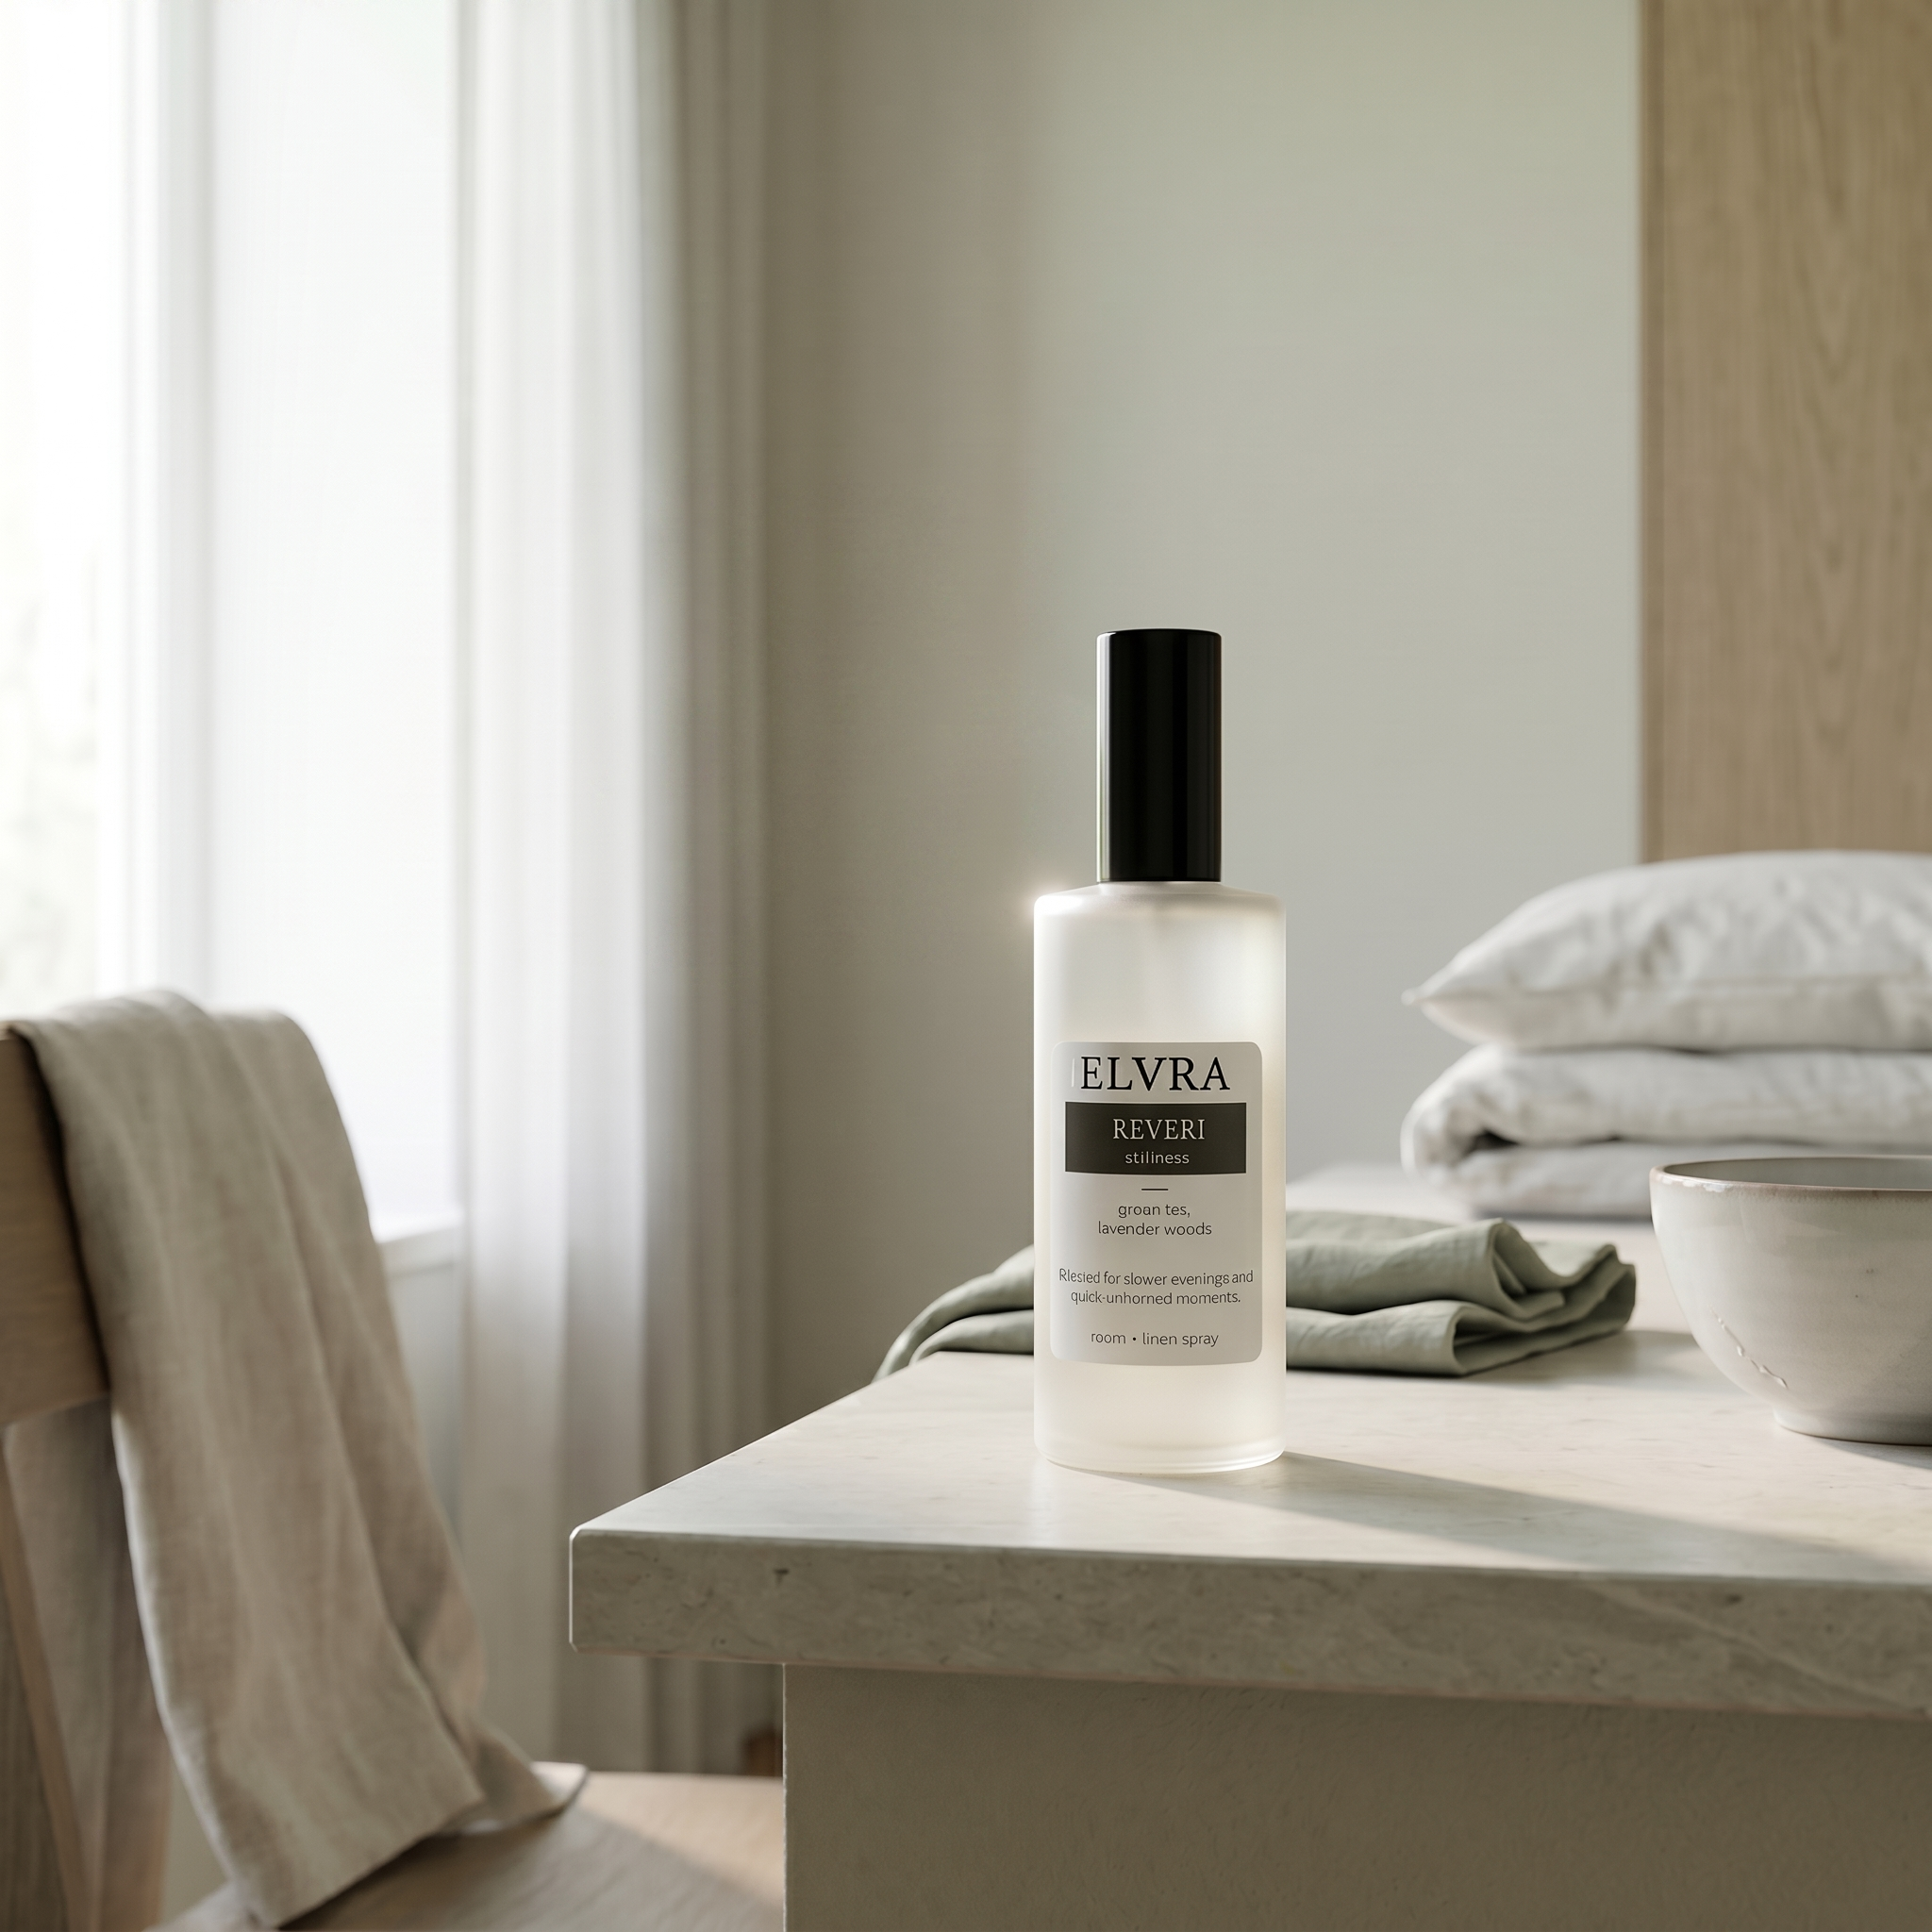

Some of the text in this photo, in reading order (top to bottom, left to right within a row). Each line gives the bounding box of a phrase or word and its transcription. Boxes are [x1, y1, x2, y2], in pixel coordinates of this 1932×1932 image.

[1081, 1056, 1230, 1091] ELVRA
[1112, 1118, 1206, 1140] REVERI
[1165, 1204, 1191, 1218] tes,
[1098, 1221, 1212, 1235] lavender woods
[1104, 1271, 1121, 1285] for
[1124, 1272, 1167, 1286] slower
[1171, 1273, 1229, 1288] evenings
[1232, 1270, 1254, 1283] and
[1176, 1291, 1241, 1305] moments.
[1091, 1332, 1219, 1348] room linen spray
